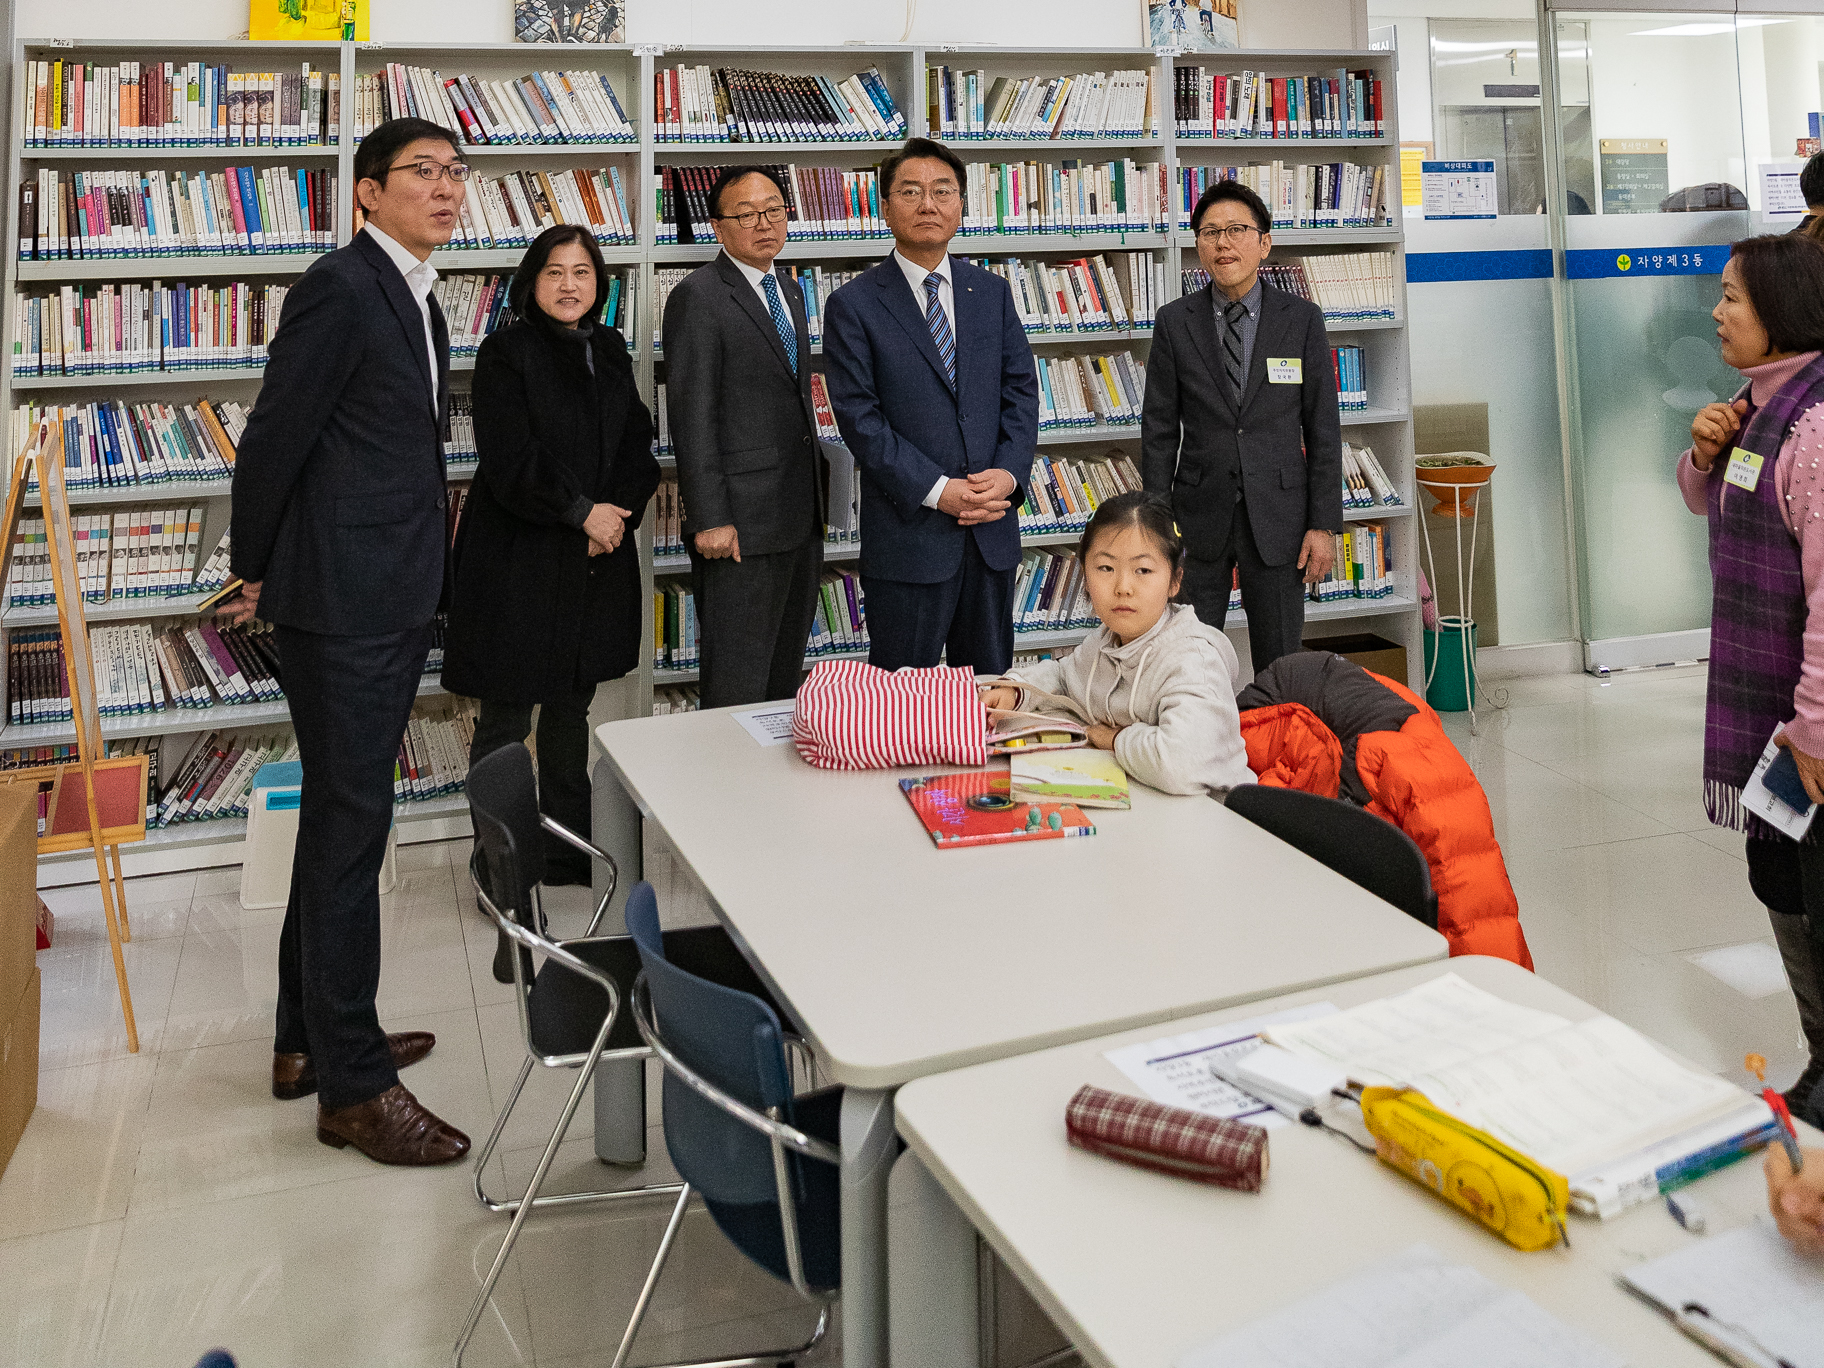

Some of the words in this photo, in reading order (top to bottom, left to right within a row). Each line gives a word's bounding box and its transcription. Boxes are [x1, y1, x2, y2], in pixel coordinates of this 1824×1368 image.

[1504, 48, 1518, 76] 1
[1620, 142, 1649, 150] 청사안내
[149, 752, 158, 777] 고구려
[215, 759, 234, 782] 1026
[234, 751, 254, 775] 고구려
[249, 751, 267, 775] 고구려
